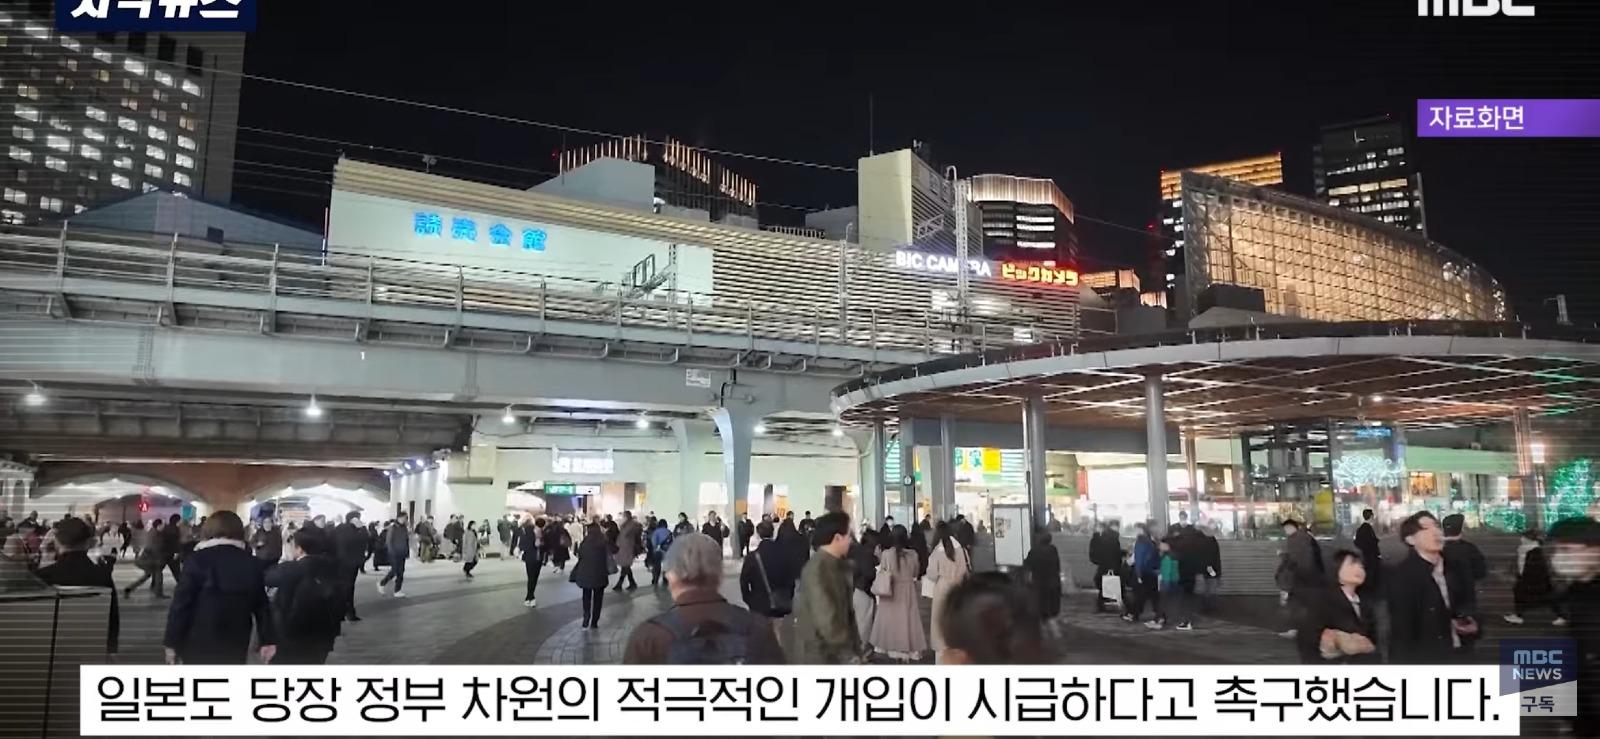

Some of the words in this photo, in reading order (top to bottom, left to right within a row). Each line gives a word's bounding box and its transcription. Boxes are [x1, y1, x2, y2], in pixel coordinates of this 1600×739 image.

[1002, 262, 1079, 287] ビックカメラ
